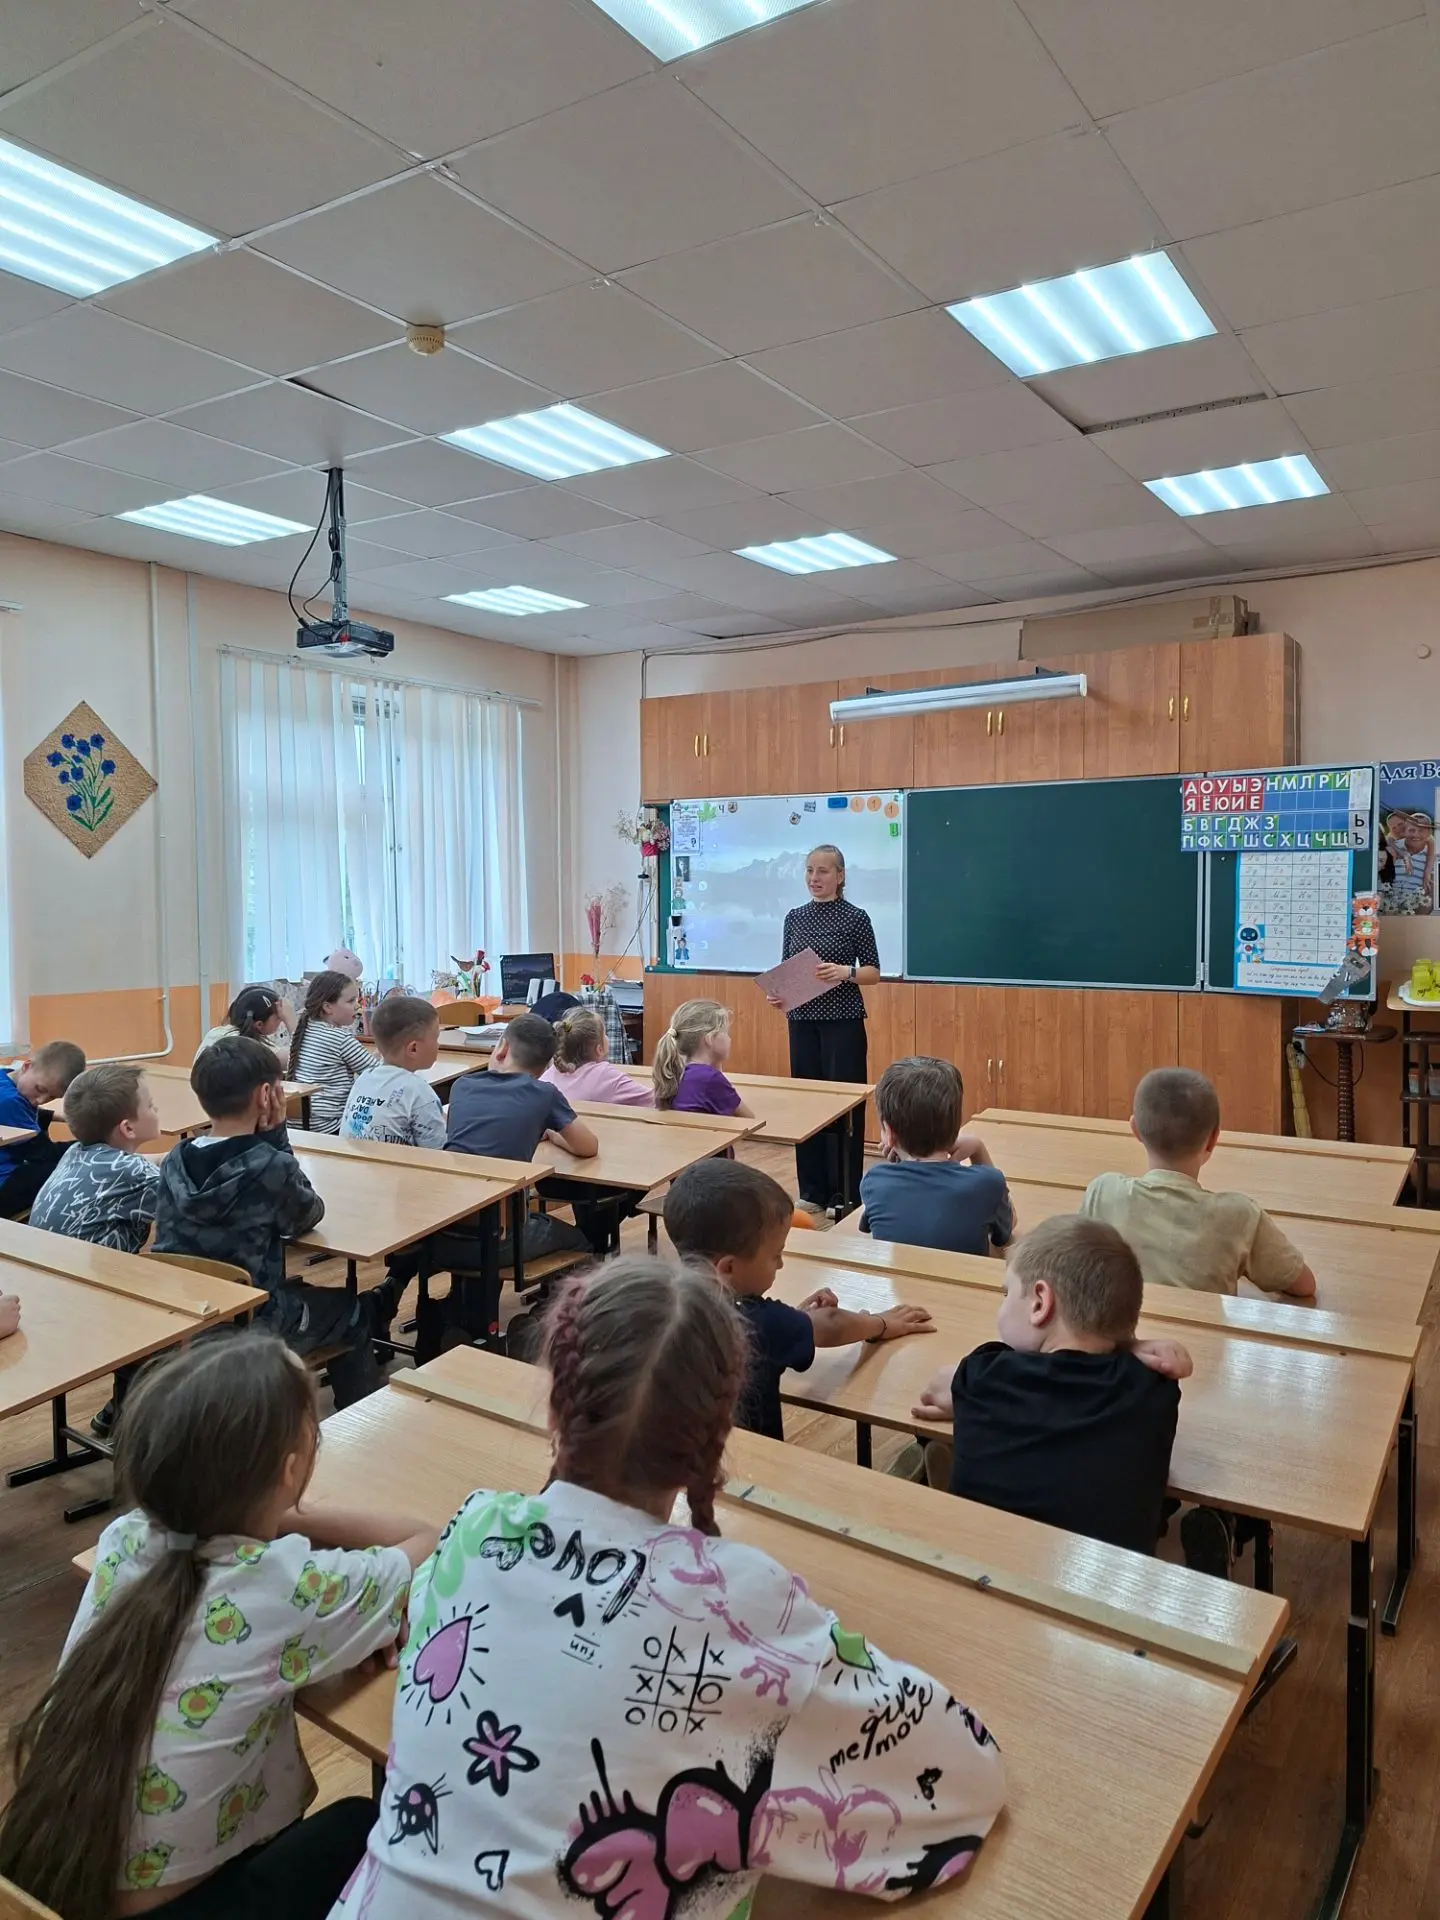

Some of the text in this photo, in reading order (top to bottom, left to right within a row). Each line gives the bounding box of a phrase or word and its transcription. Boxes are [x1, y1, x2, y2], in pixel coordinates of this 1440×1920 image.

[1380, 764, 1417, 784] Для
[1184, 781, 1197, 795] А
[1200, 780, 1213, 793] О
[1214, 779, 1227, 793] У
[1232, 779, 1246, 792] Ы
[1250, 778, 1262, 792] Э
[1266, 777, 1278, 791] Н
[1282, 776, 1297, 791] М
[1300, 775, 1312, 790] Л
[1319, 774, 1329, 788] Р
[1184, 795, 1260, 812] Я Ё Ю И Е
[1183, 819, 1193, 832] Б
[1200, 819, 1209, 831] В
[1214, 818, 1224, 831] Г
[1228, 818, 1241, 832] Д
[1244, 817, 1259, 830] Ж
[1354, 813, 1365, 828] Ь
[1183, 832, 1365, 848] П Ф К Т Ш С Х Ц Ч Щ Ъ
[829, 1682, 934, 1775] me more
[860, 1676, 918, 1761] give
